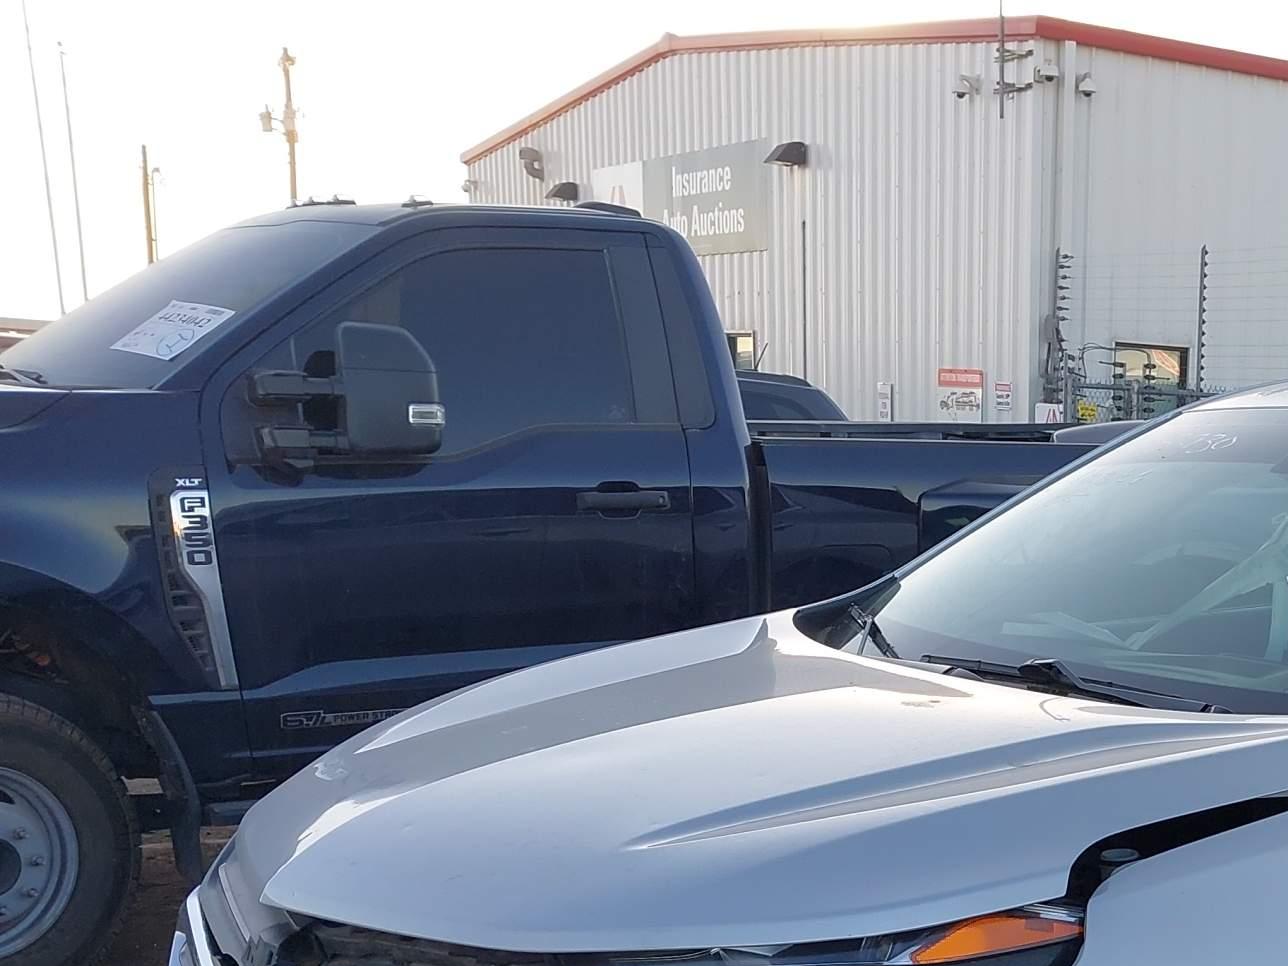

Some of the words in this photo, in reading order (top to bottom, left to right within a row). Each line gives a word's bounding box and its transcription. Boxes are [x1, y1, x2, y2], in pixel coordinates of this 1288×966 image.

[672, 166, 732, 198] Insurance
[662, 208, 688, 238] Auto
[690, 201, 745, 237] Auctions
[174, 478, 203, 487] XLT
[179, 496, 213, 566] F350
[333, 711, 370, 723] POWER
